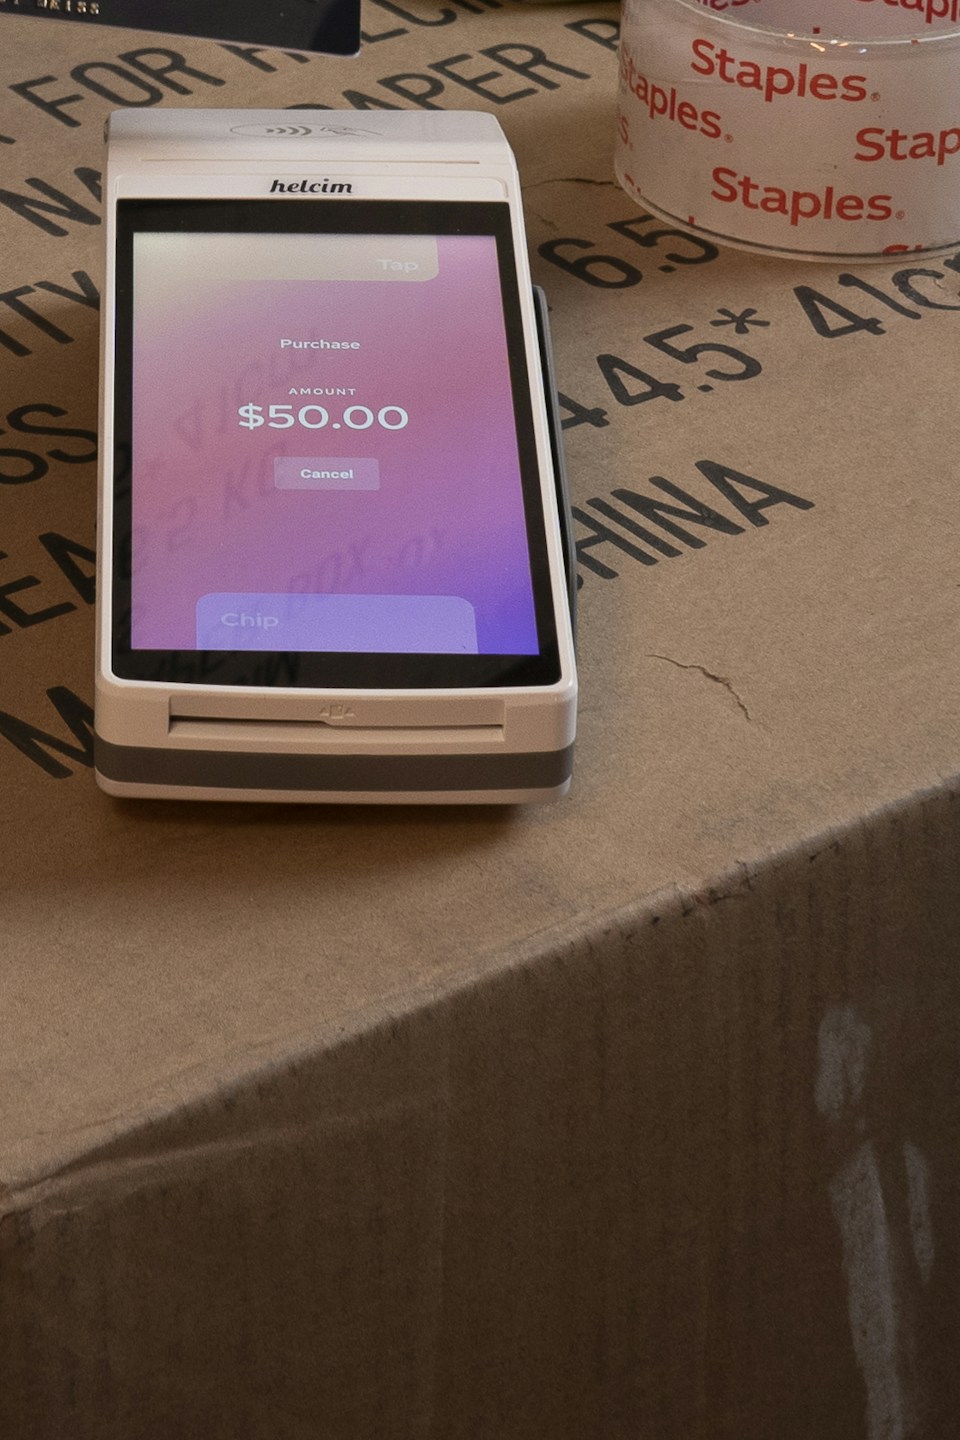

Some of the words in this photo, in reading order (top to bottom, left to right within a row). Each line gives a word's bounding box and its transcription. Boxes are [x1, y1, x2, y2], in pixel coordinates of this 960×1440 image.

[9, 46, 226, 128] FOR
[270, 178, 353, 193] helcim
[537, 215, 719, 289] 6.5
[377, 258, 419, 273] Tap
[280, 338, 361, 350] Purchase
[288, 387, 357, 397] AMOUNT
[238, 402, 409, 431] $50.00
[300, 468, 354, 480] Cancel
[575, 460, 816, 591] HINA
[221, 613, 279, 630] Chip
